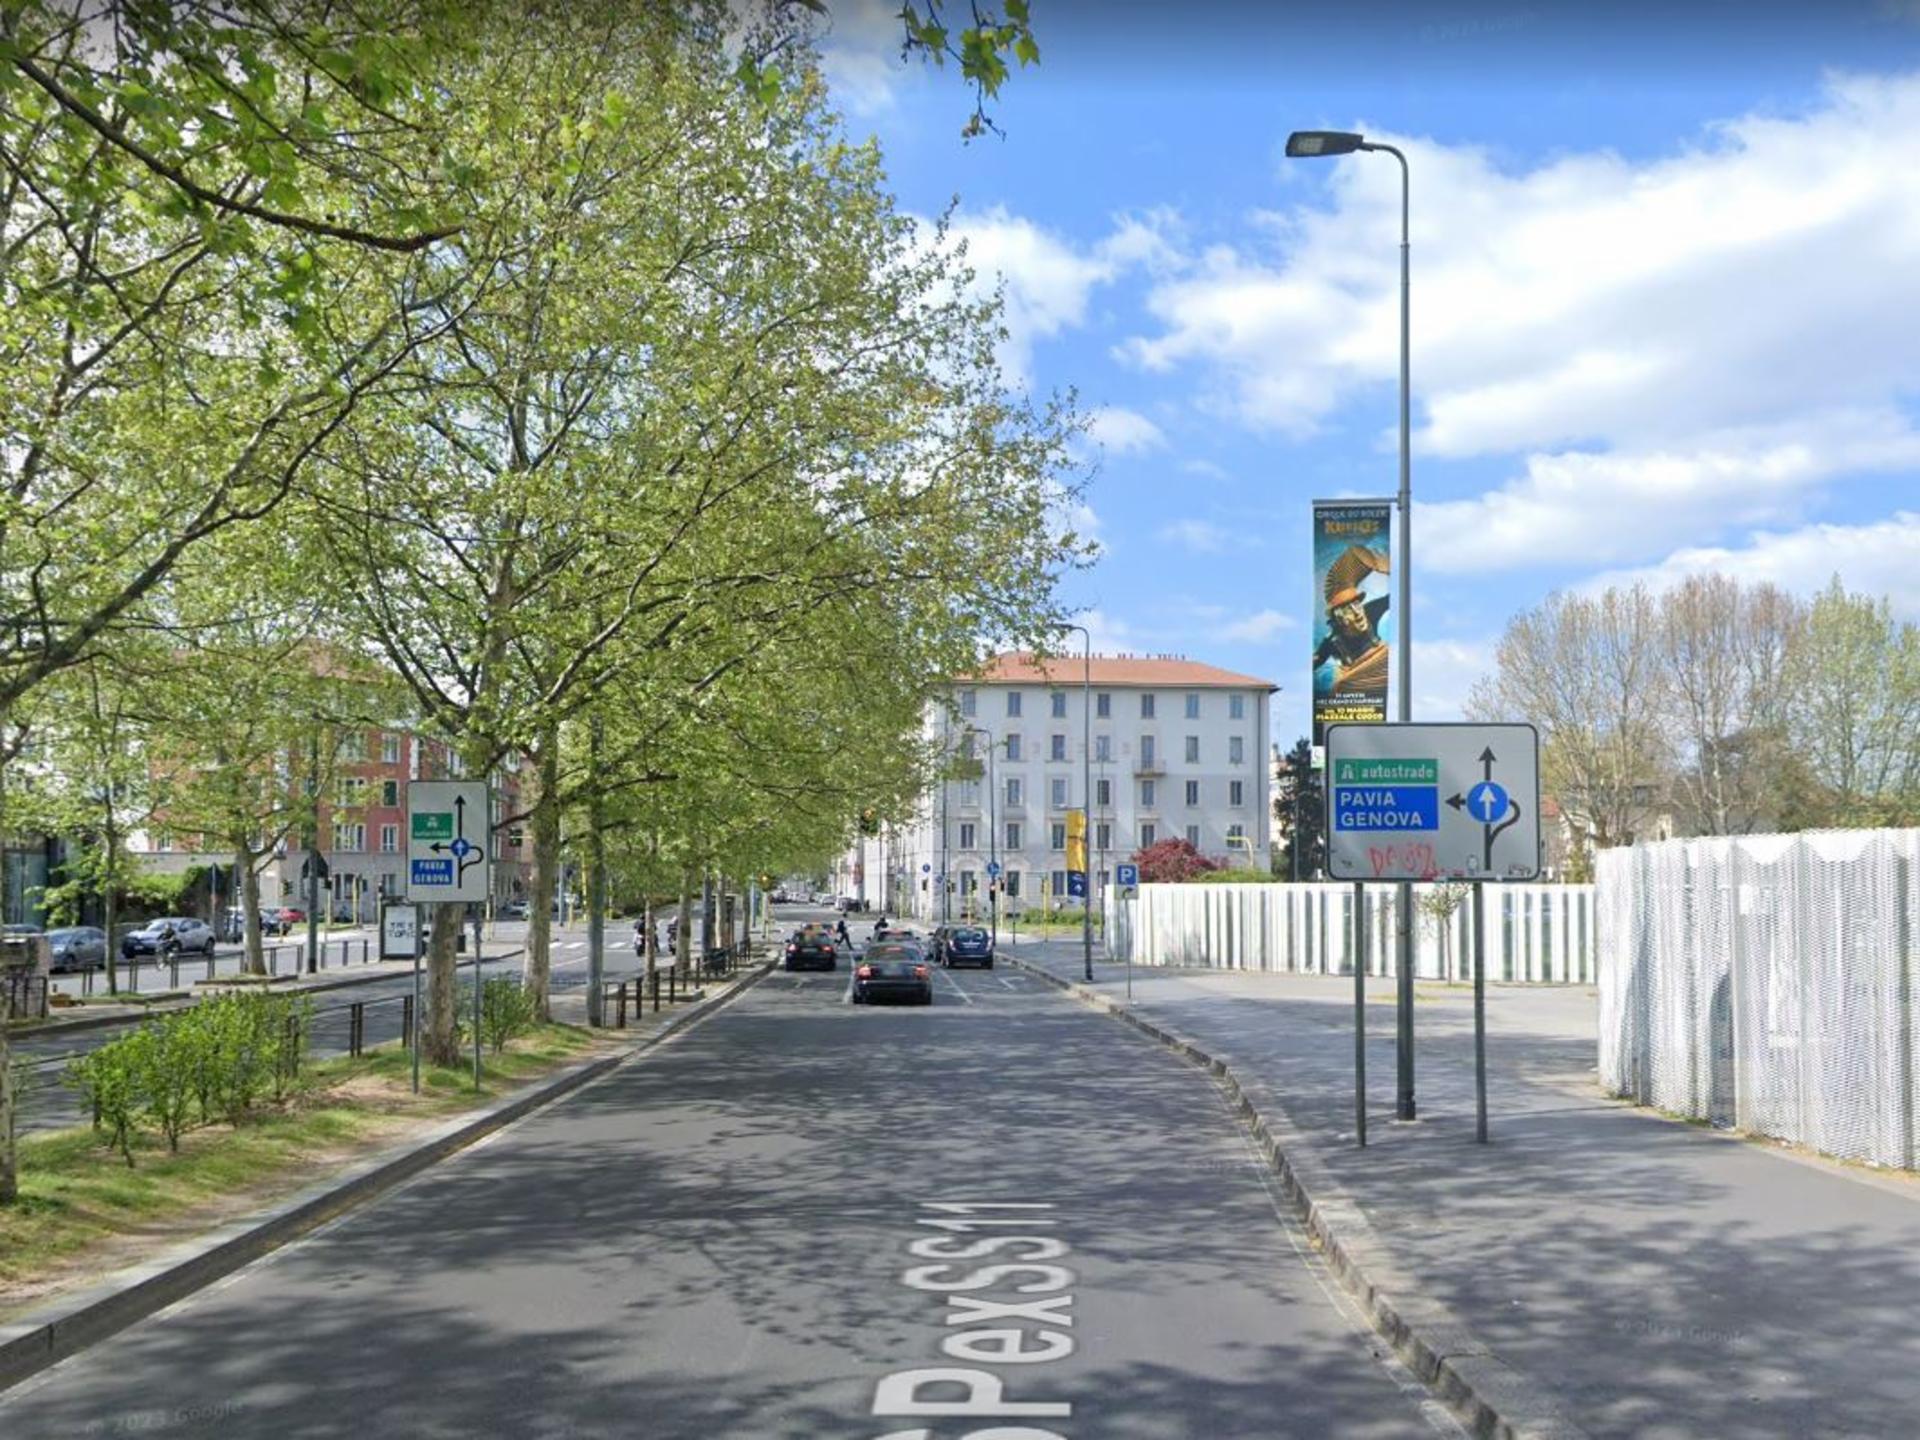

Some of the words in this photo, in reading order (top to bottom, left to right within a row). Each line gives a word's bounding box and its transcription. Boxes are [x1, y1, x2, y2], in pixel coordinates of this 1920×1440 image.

[1361, 764, 1434, 779] autostrade
[1340, 792, 1396, 807] PAVIA
[1341, 811, 1423, 827] GENOVA
[1121, 868, 1133, 883] P
